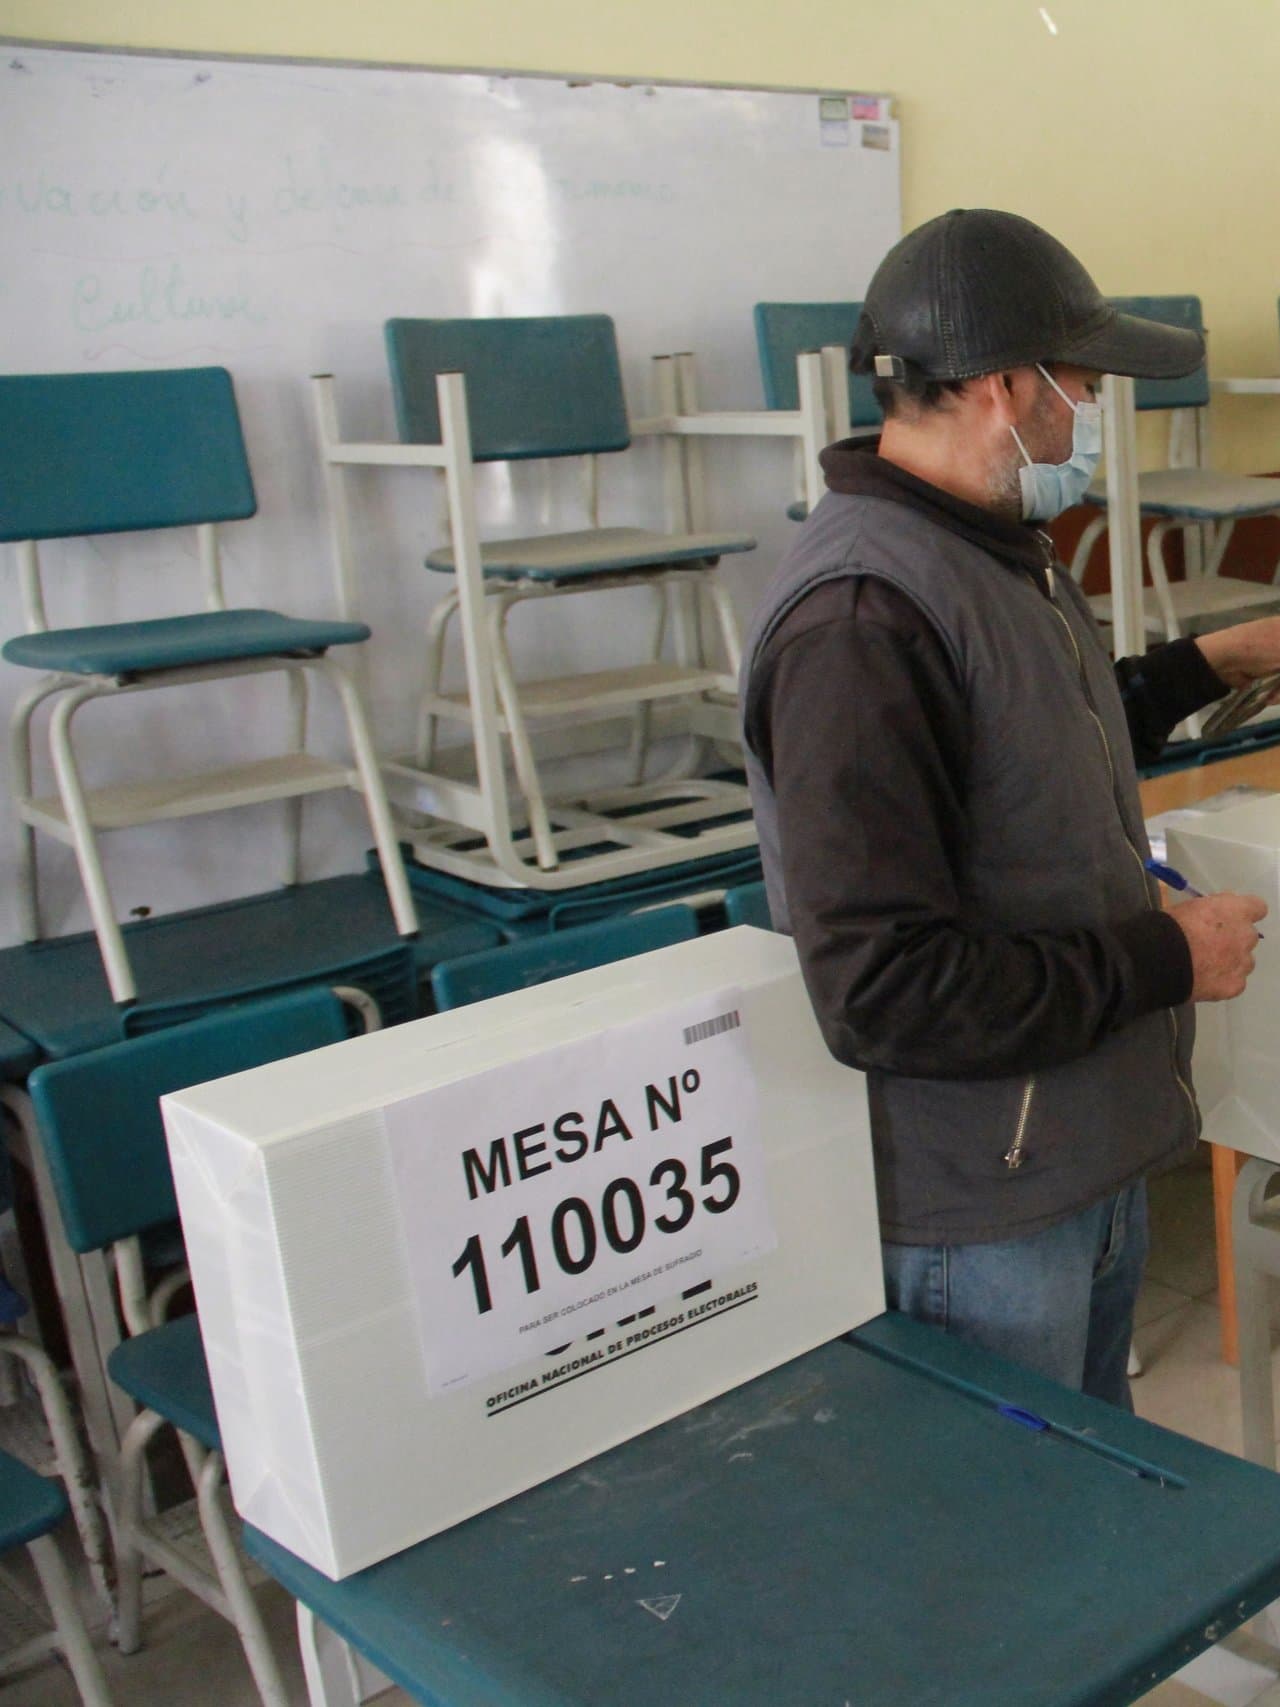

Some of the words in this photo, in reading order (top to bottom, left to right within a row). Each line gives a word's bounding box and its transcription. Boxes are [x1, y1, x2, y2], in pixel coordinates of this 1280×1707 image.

[462, 1098, 633, 1200] MESA
[451, 1135, 741, 1315] 110035
[486, 1378, 539, 1408] OFICINA
[541, 1349, 605, 1384] NACIONAL
[607, 1340, 623, 1355] DE
[625, 1313, 685, 1347] PROCESOS
[687, 1281, 758, 1320] ELECTORALES
[518, 1320, 541, 1334] PARA
[542, 1311, 559, 1323] SER
[560, 1291, 605, 1316] COLOCADO
[607, 1286, 618, 1296] EN
[619, 1281, 630, 1290] LA
[630, 1272, 652, 1285] MESA
[653, 1266, 663, 1276] DE
